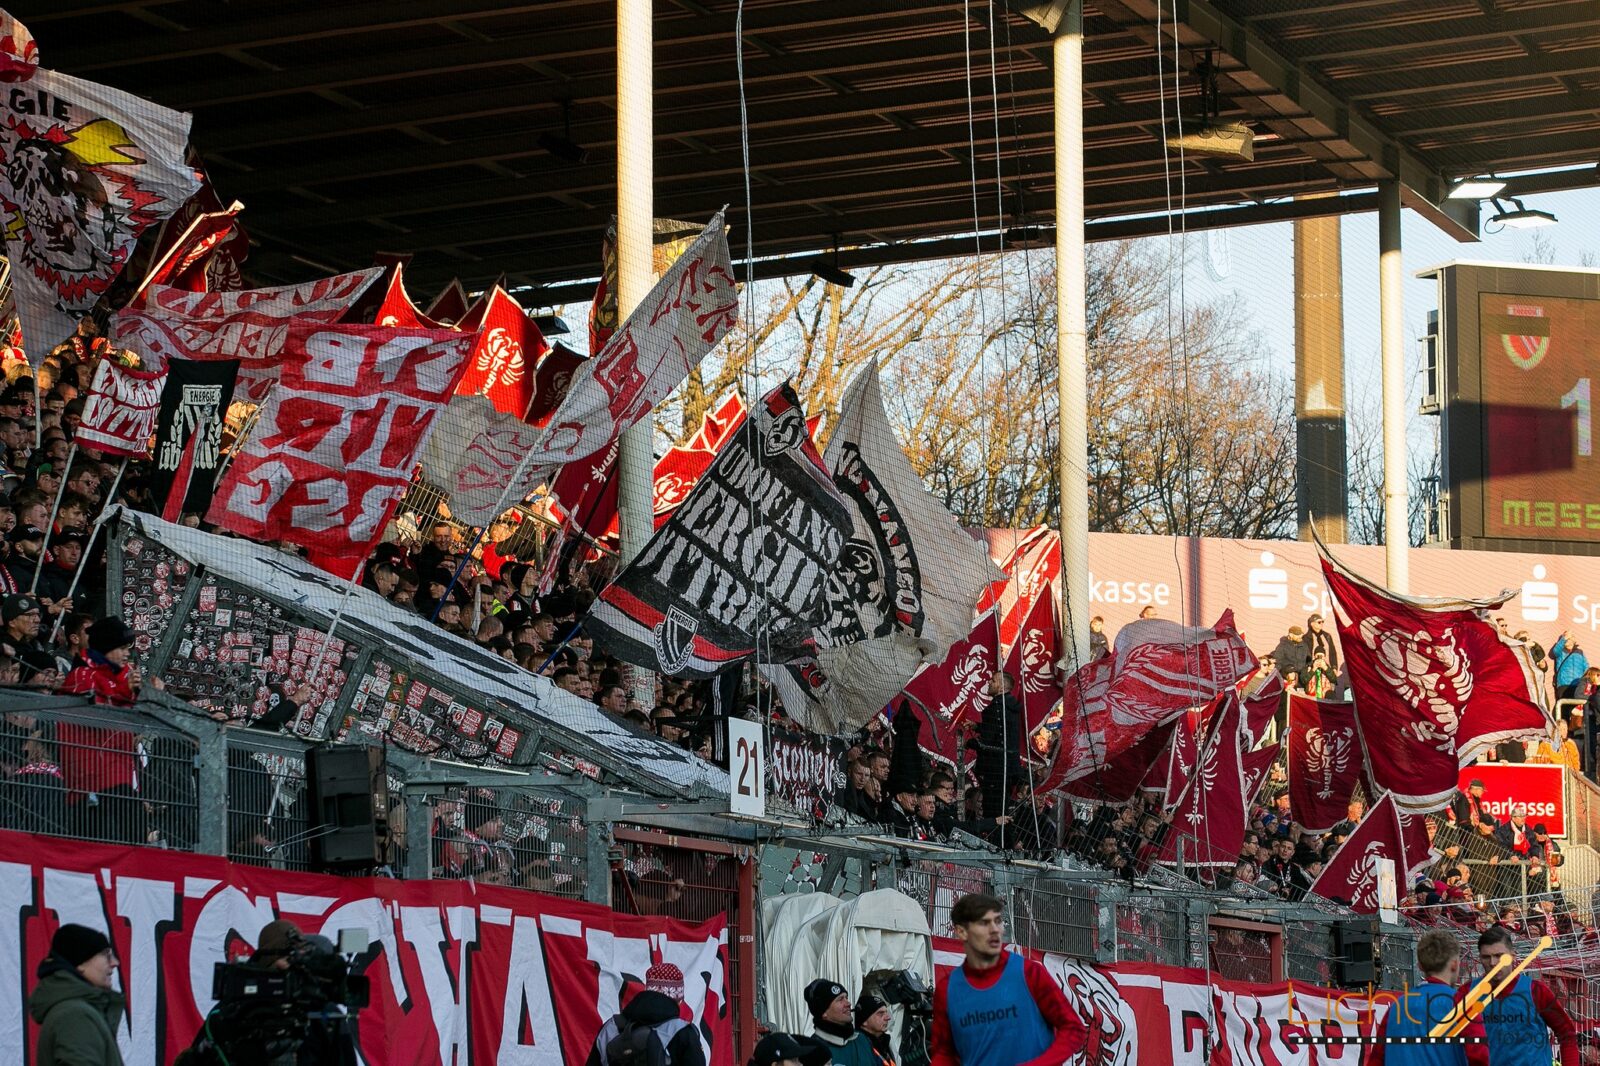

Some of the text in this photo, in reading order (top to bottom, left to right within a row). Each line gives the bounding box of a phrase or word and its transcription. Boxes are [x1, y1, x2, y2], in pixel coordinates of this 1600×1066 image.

[189, 390, 216, 403] ENERGIE
[1561, 378, 1592, 456] 1
[1089, 573, 1170, 605] kasse
[669, 609, 695, 630] ENERGIE
[736, 736, 759, 798] 21
[1481, 796, 1555, 816] parkasse
[960, 1004, 1018, 1028] uhlsport
[1483, 1009, 1524, 1026] hlsport
